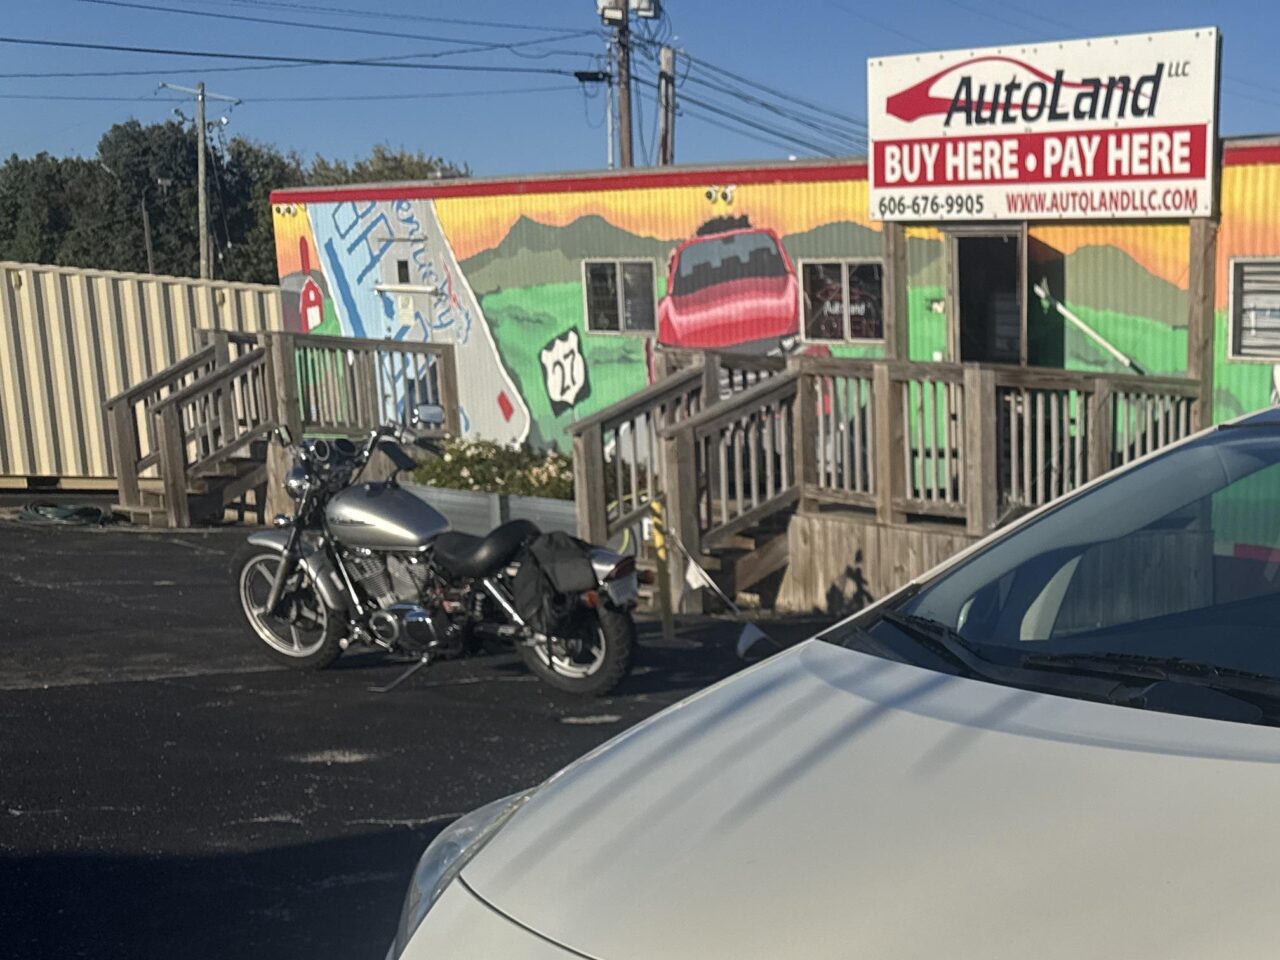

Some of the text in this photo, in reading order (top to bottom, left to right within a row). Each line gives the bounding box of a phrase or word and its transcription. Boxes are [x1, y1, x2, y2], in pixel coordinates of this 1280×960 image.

[944, 60, 1191, 127] AutoLand LLC
[884, 130, 1192, 184] BUY HERE PAY HERE
[878, 187, 1198, 216] 606-676-9905 WWW.AUTOLANDLLC.COM
[552, 348, 577, 397] 27
